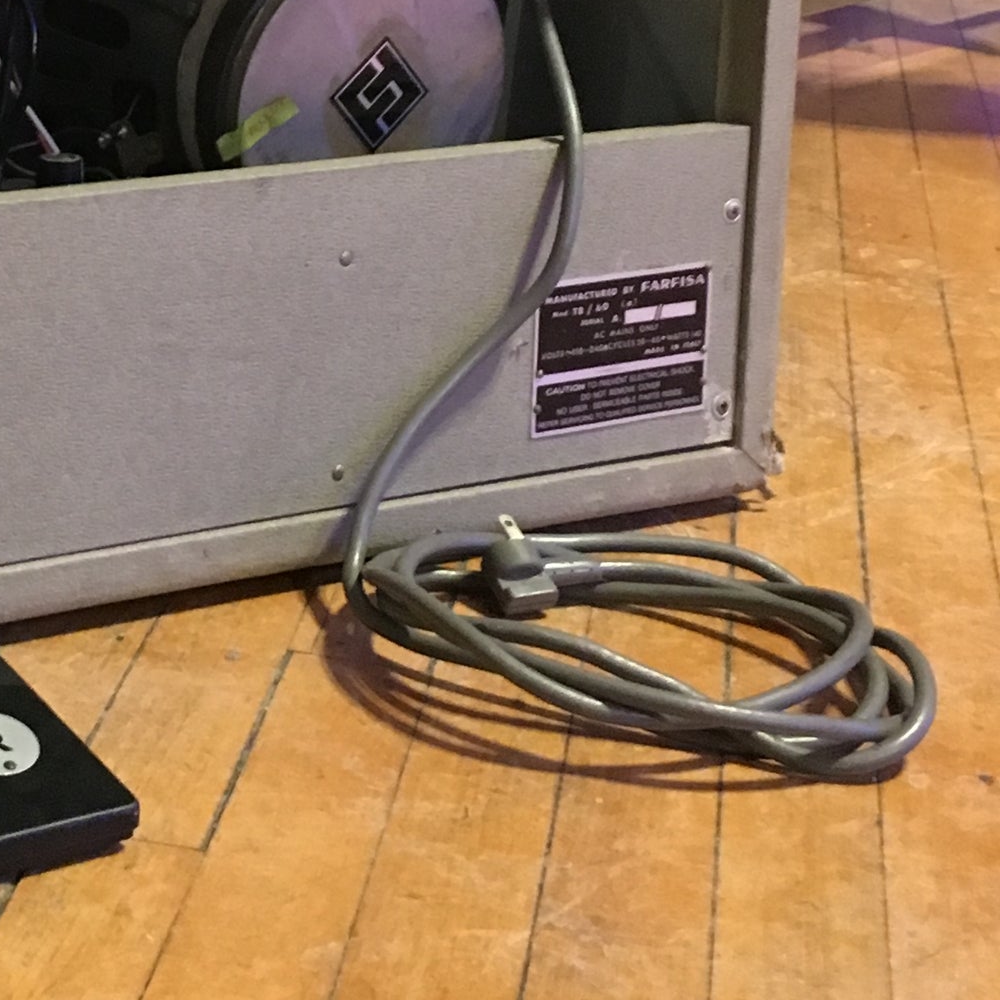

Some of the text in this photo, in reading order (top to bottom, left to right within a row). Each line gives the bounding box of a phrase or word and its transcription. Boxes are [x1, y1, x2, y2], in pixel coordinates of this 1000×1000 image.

[545, 273, 706, 305] MANUFACTURED BY FARFISA
[639, 323, 659, 333] ONLY
[545, 383, 586, 396] CAUTION
